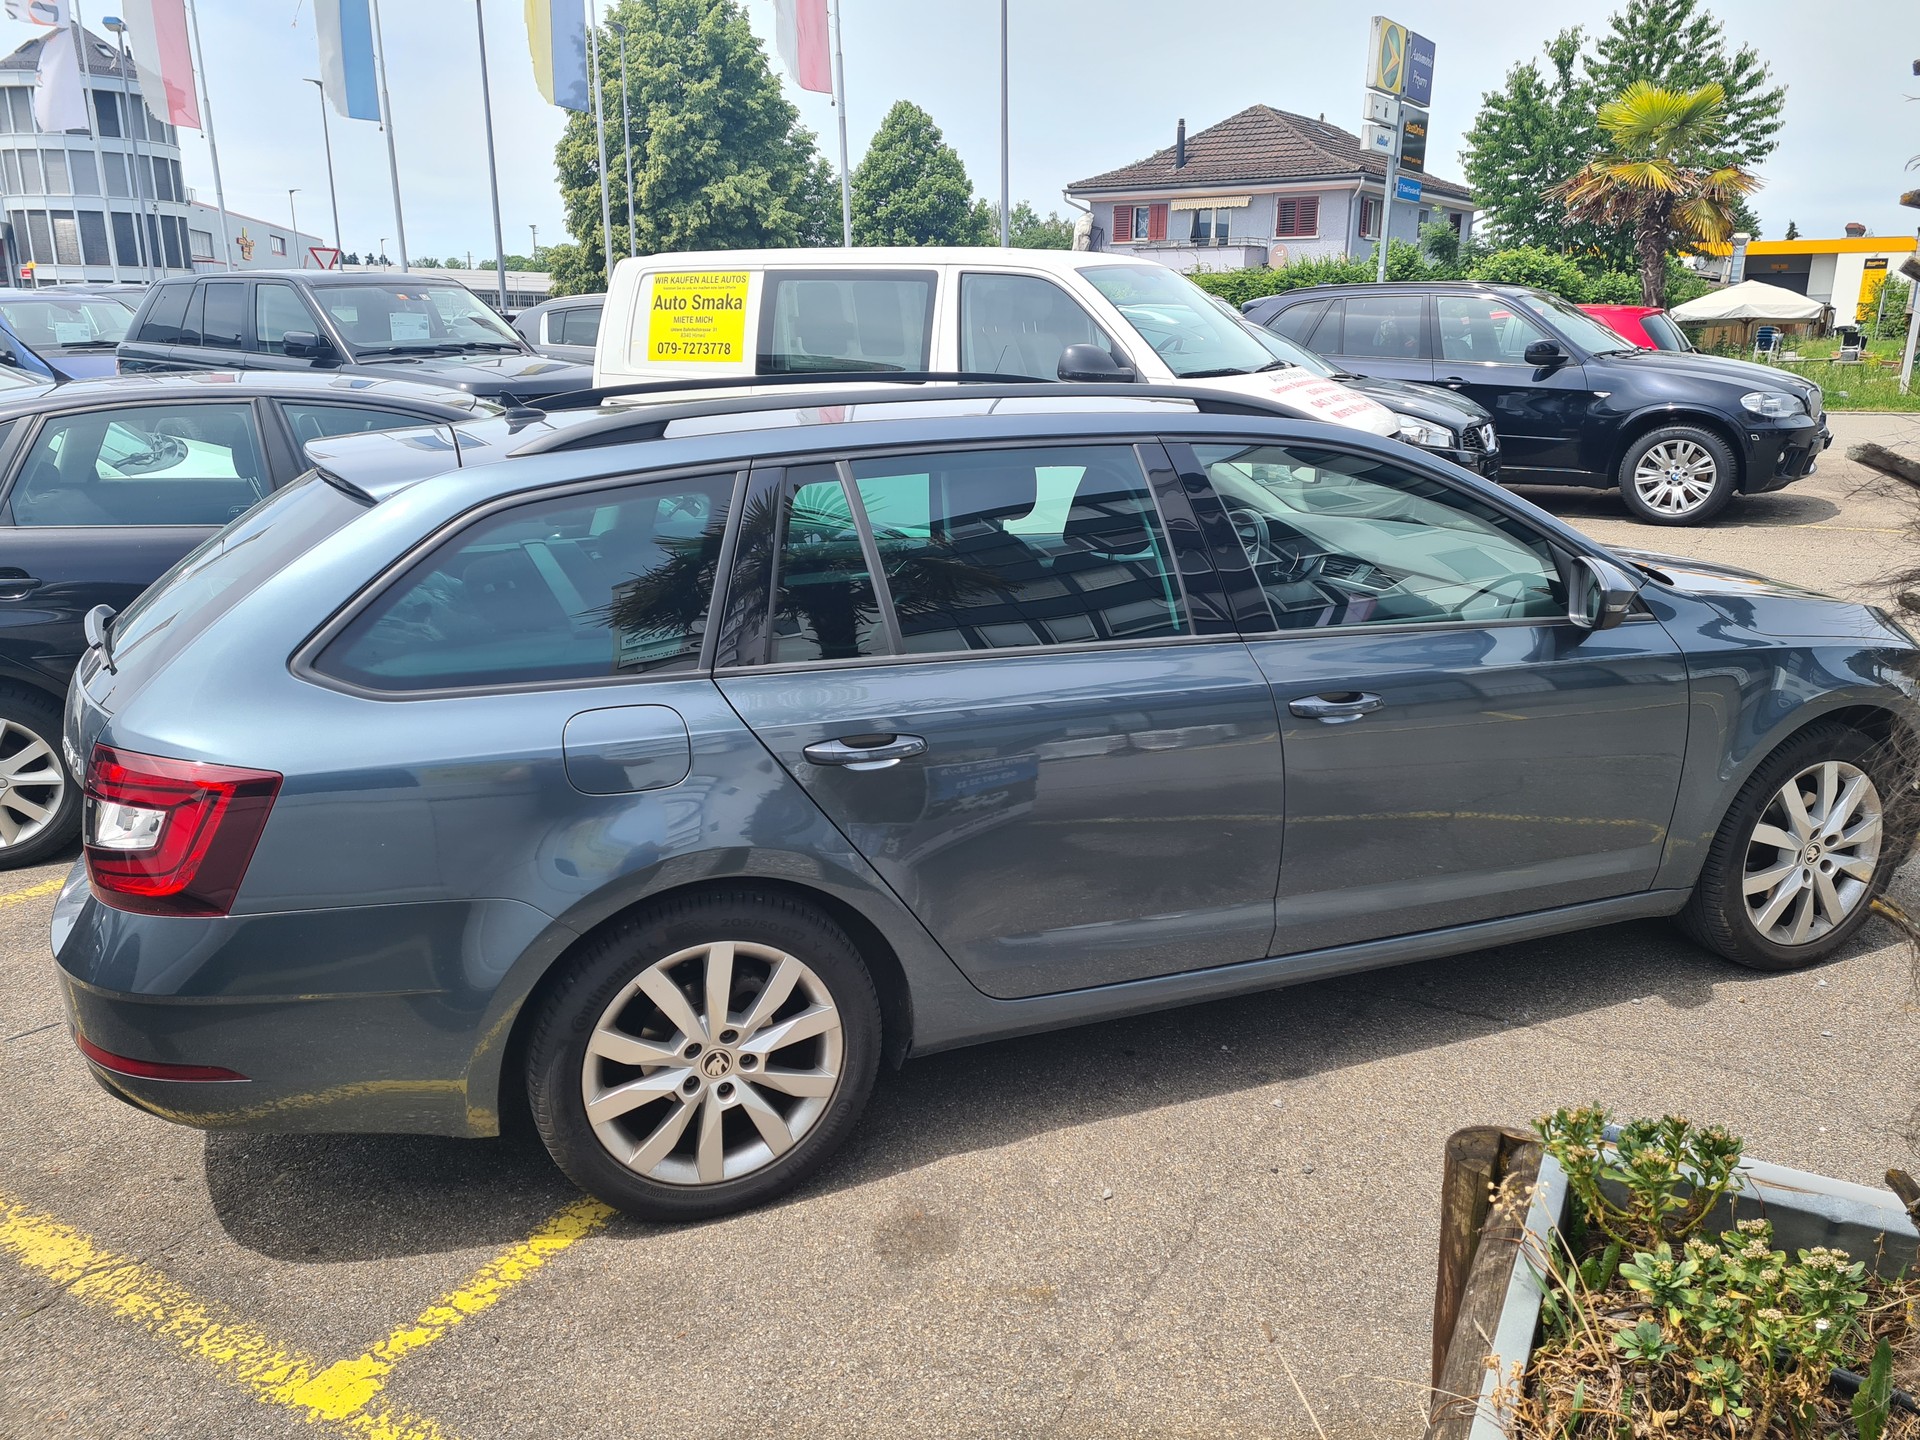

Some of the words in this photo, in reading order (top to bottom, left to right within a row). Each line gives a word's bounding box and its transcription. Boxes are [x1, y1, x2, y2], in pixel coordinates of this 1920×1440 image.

[655, 276, 669, 284] WIR
[670, 275, 700, 284] KAUFEN
[701, 275, 719, 284] ALLE
[720, 275, 747, 283] AUTOS
[653, 294, 687, 310] Auto
[691, 293, 742, 310] Smaka
[657, 342, 731, 354] 079-7273778
